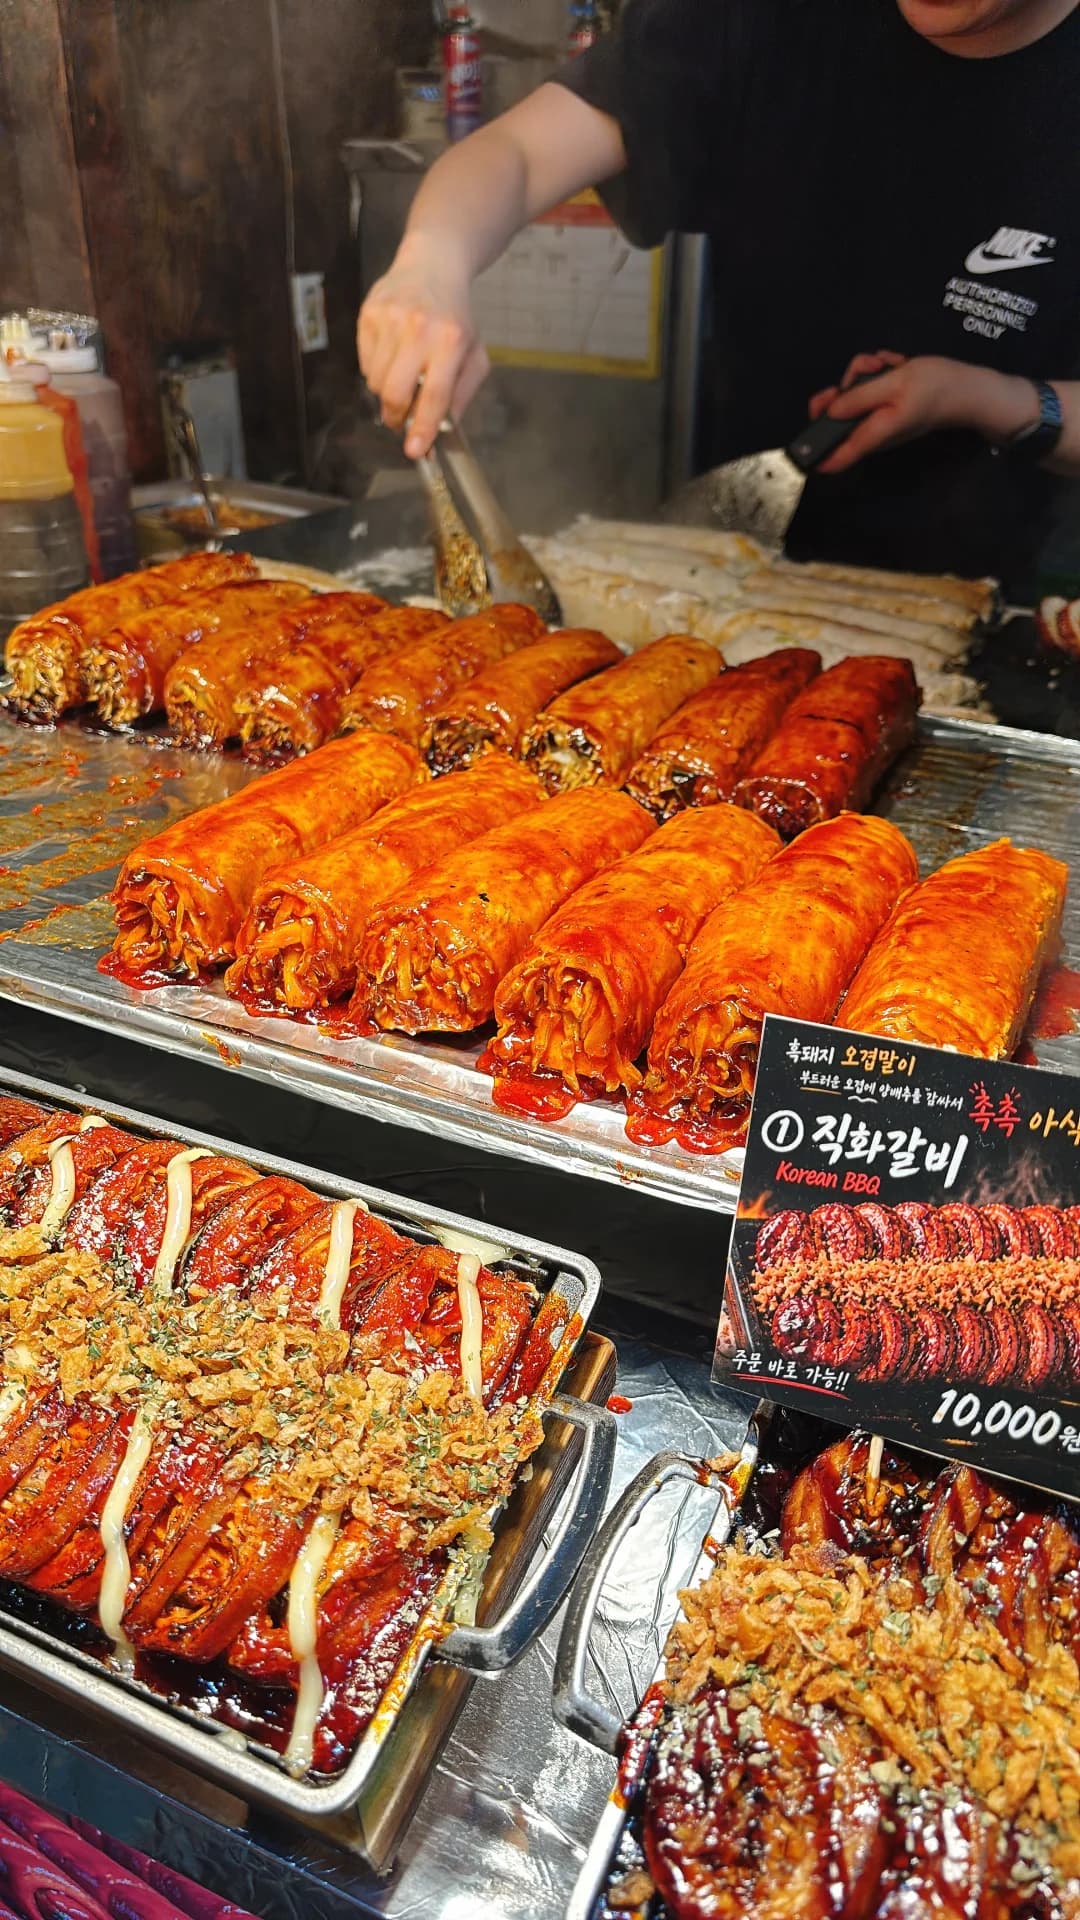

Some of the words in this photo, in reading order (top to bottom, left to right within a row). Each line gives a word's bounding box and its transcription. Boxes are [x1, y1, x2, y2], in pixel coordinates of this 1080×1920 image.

[984, 226, 1049, 258] NIKE
[945, 277, 1038, 316] AUTHORIZED
[963, 315, 1007, 339] ONLY
[786, 1038, 835, 1065] 흑돼지
[841, 1045, 916, 1077] 오겹말이
[800, 1070, 841, 1089] 부드러운
[843, 1078, 876, 1095] 오겹에
[879, 1083, 922, 1105] 양배추를
[926, 1090, 964, 1111] 감싸서
[969, 1088, 1021, 1138] 촉촉
[811, 1113, 969, 1188] 직화갈비
[775, 1160, 838, 1188] Korean
[842, 1171, 881, 1195] BBQ
[732, 1349, 762, 1373] 주문
[768, 1359, 798, 1379] 바로
[805, 1366, 850, 1391] 가능!!
